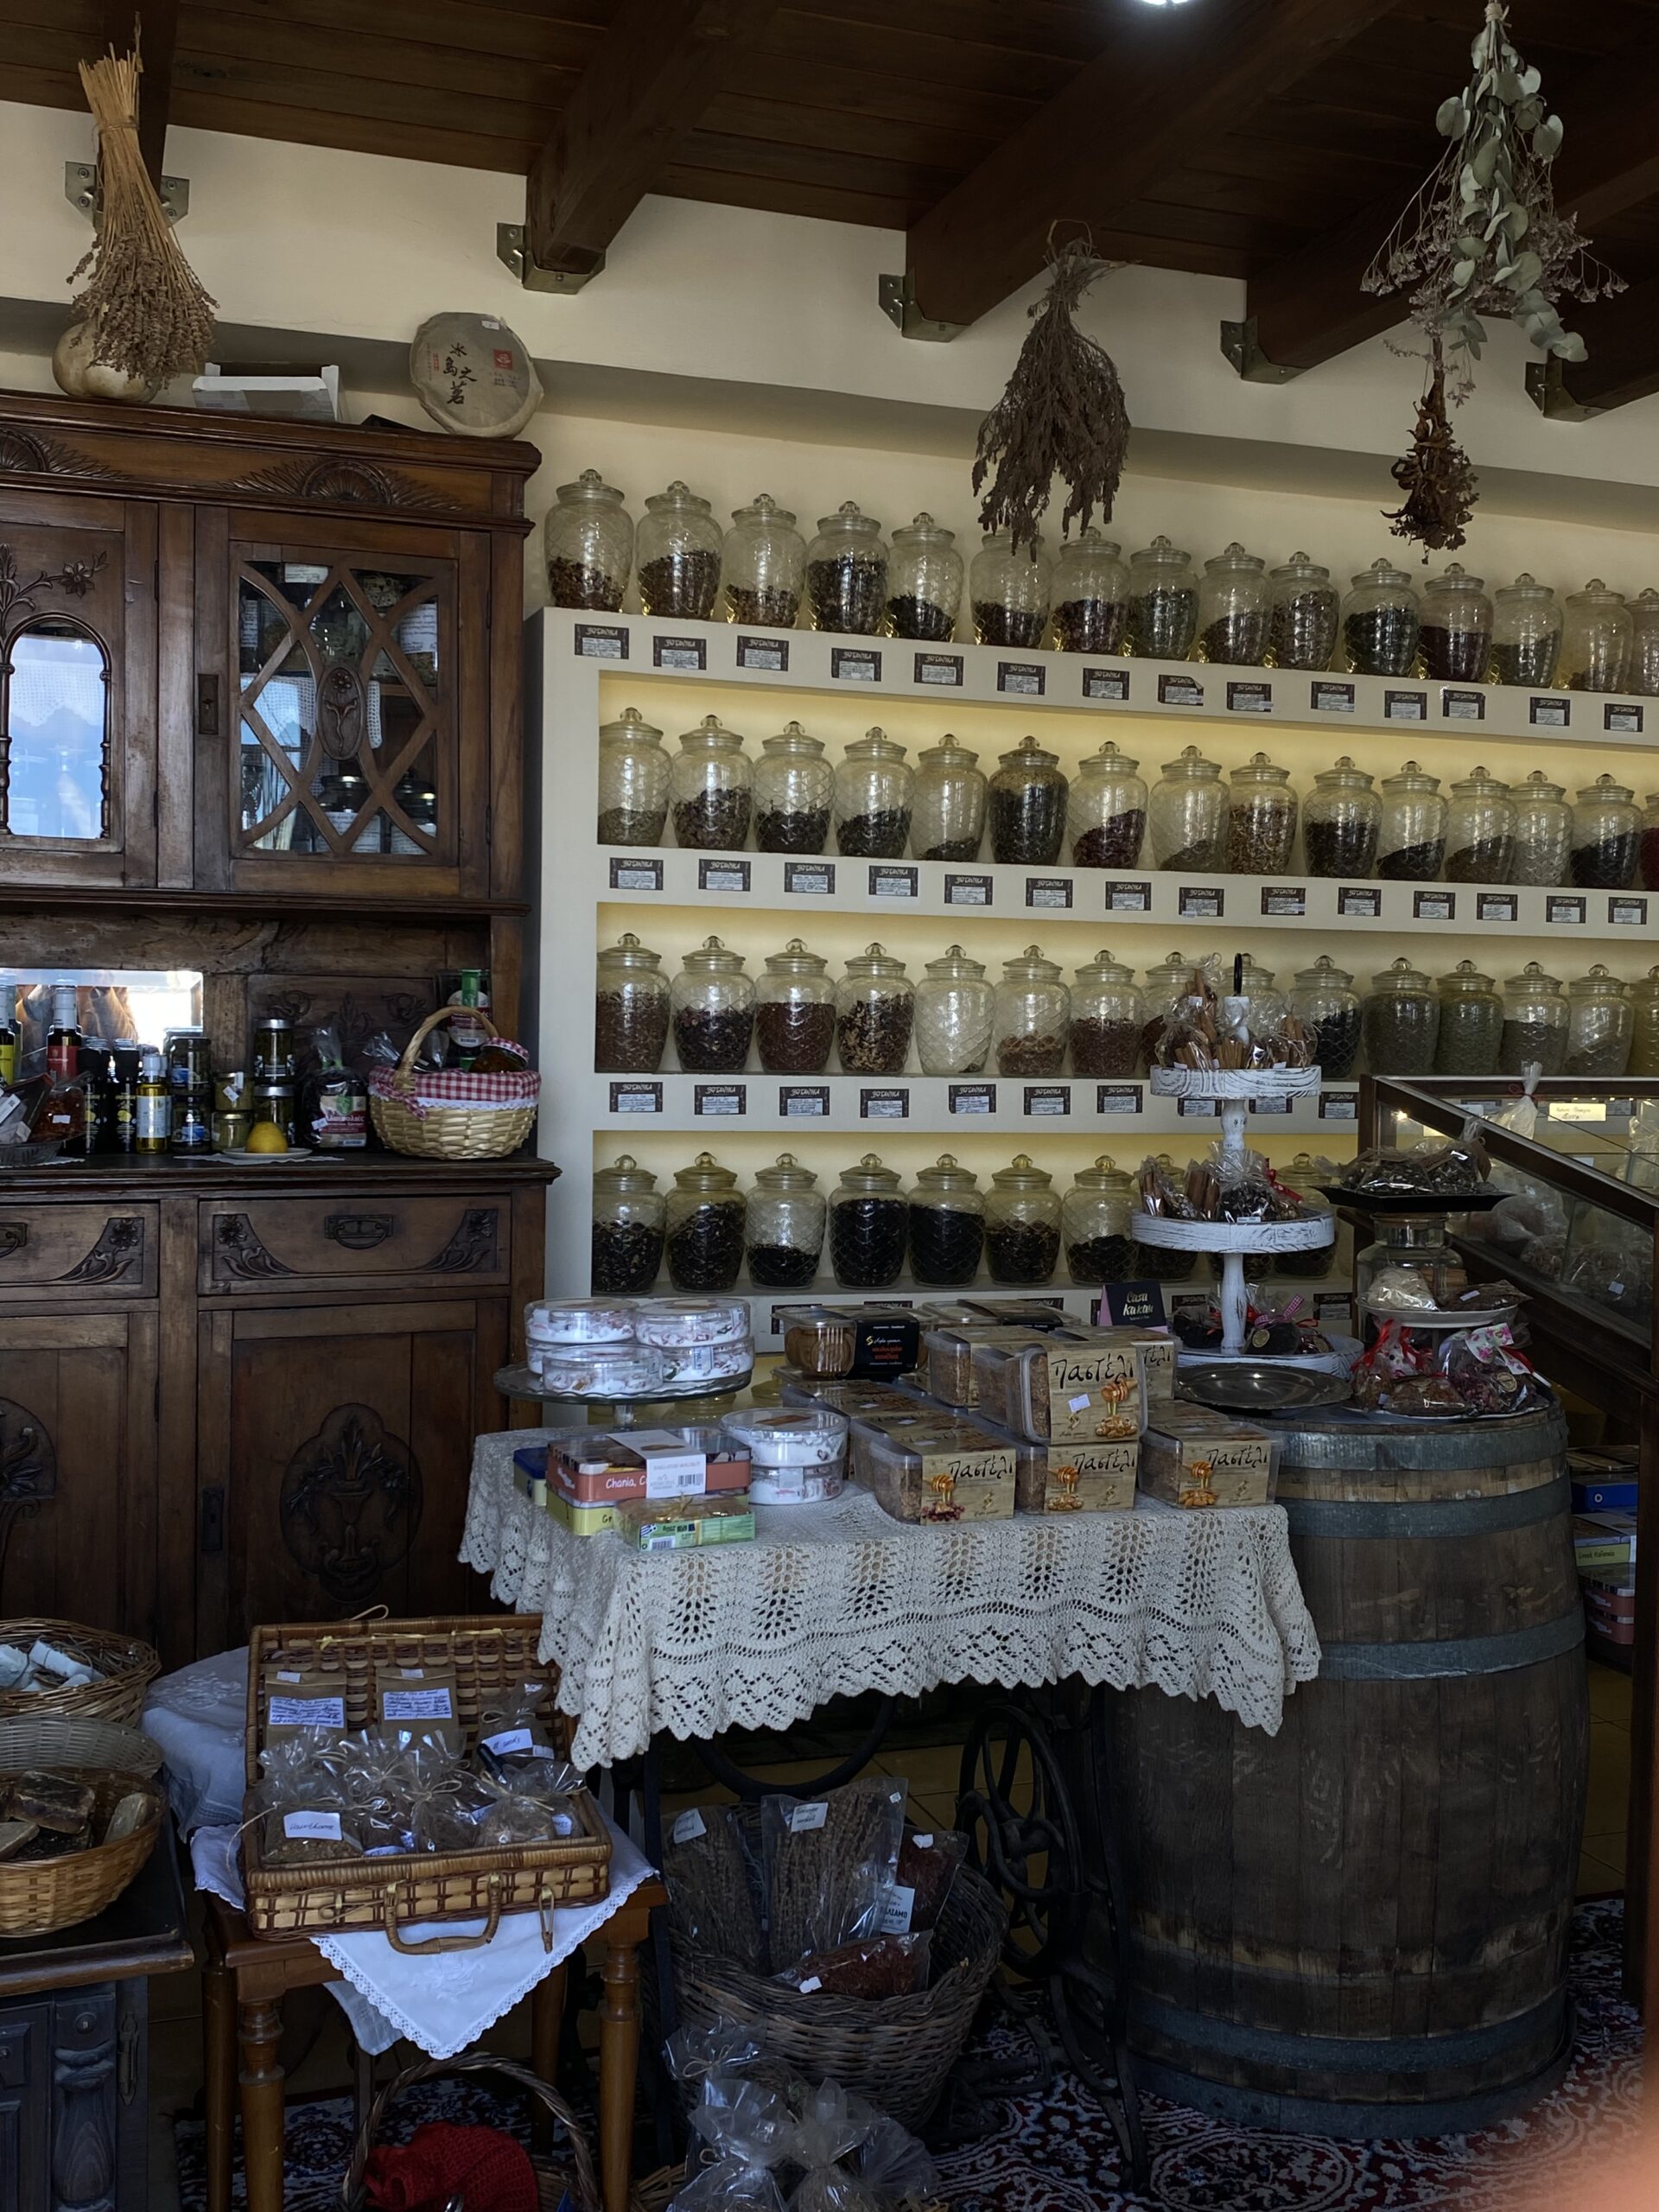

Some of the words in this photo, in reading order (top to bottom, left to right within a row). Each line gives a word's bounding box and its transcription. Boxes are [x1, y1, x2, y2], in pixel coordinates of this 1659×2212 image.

[1051, 1353, 1134, 1389] Παστέλι
[948, 1455, 1013, 1483] Παστέλι
[1072, 1449, 1135, 1474] Παστέλι
[1206, 1446, 1268, 1470] Παστέλι
[606, 1477, 637, 1489] Chania,
